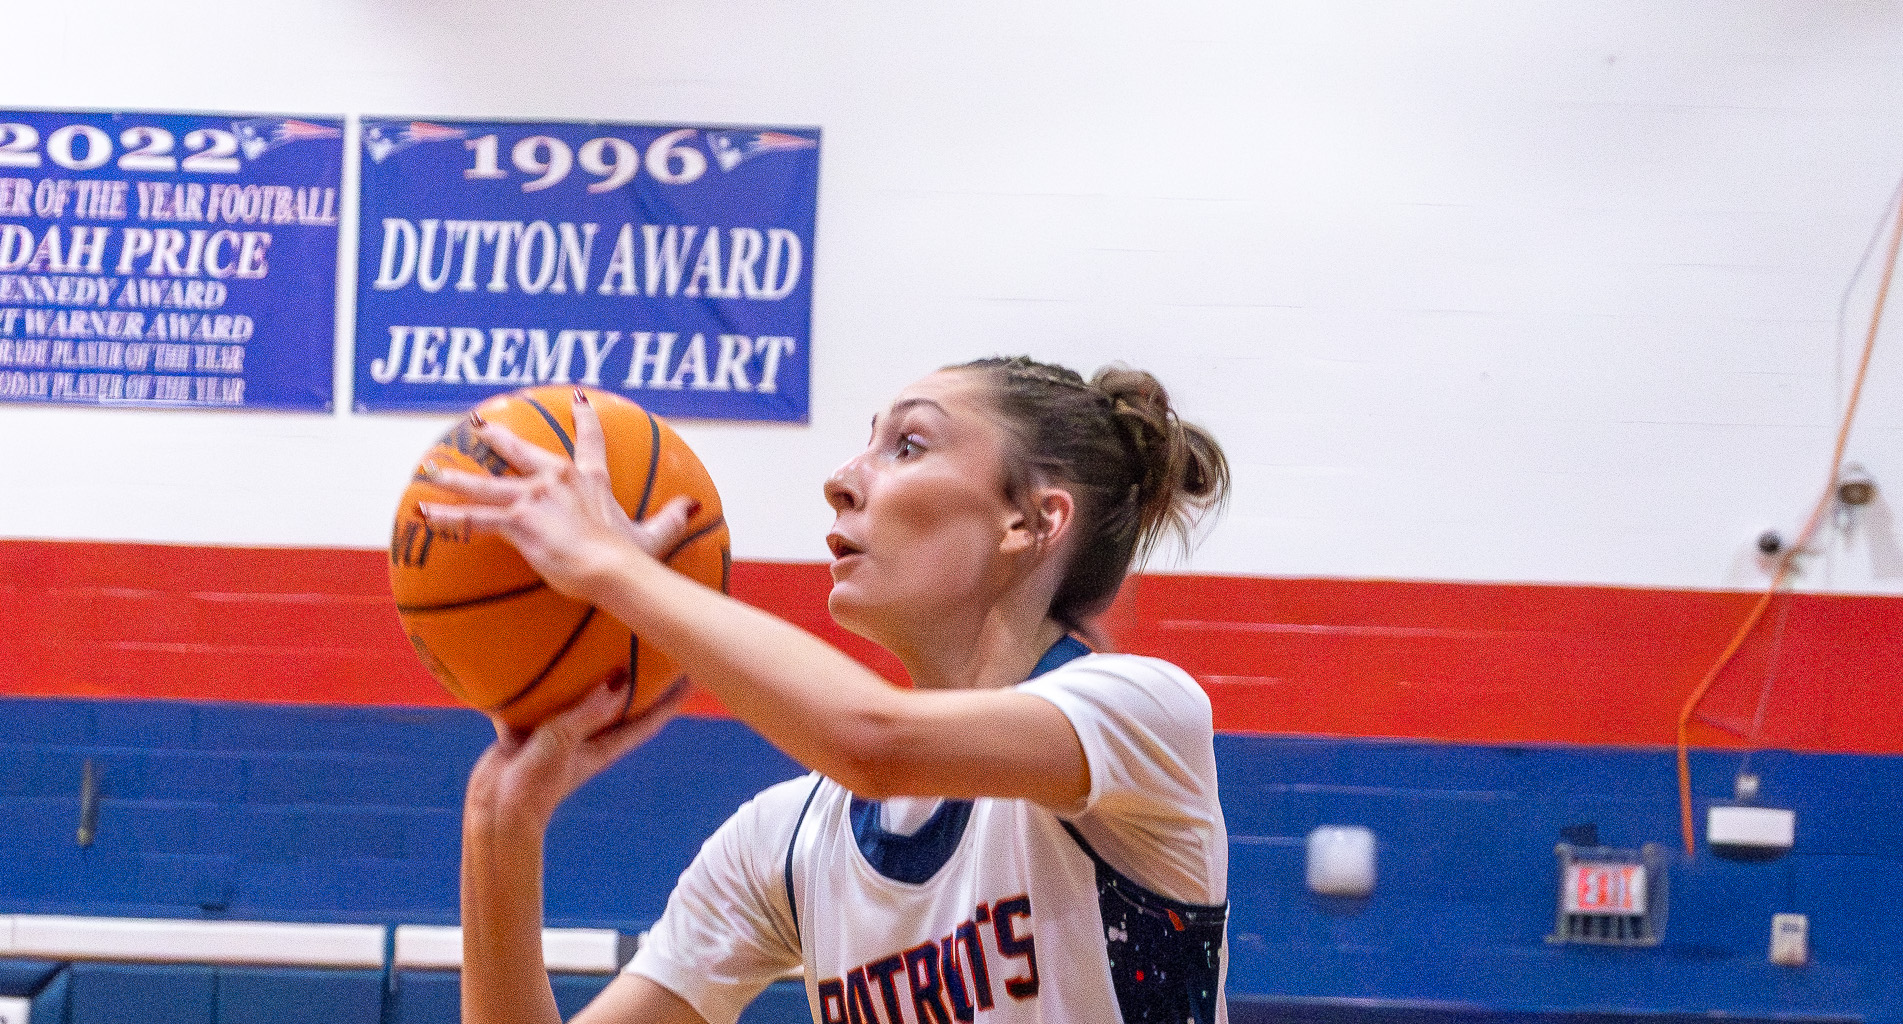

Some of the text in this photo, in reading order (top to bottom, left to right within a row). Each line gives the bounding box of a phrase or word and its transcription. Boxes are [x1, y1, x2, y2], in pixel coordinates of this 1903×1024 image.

[0, 122, 241, 172] 2022
[463, 129, 708, 193] 1996
[35, 178, 71, 218] OF
[74, 180, 129, 220] THE
[137, 181, 204, 222] YEAR
[206, 183, 337, 226] FOOTBALL
[0, 224, 272, 279] DAH PRICE
[373, 217, 802, 300] DUTTON AWARD
[116, 278, 227, 309] AWARD
[25, 309, 145, 338] WARNER
[145, 312, 254, 341] AWARD
[370, 325, 796, 393] JEREMY HART
